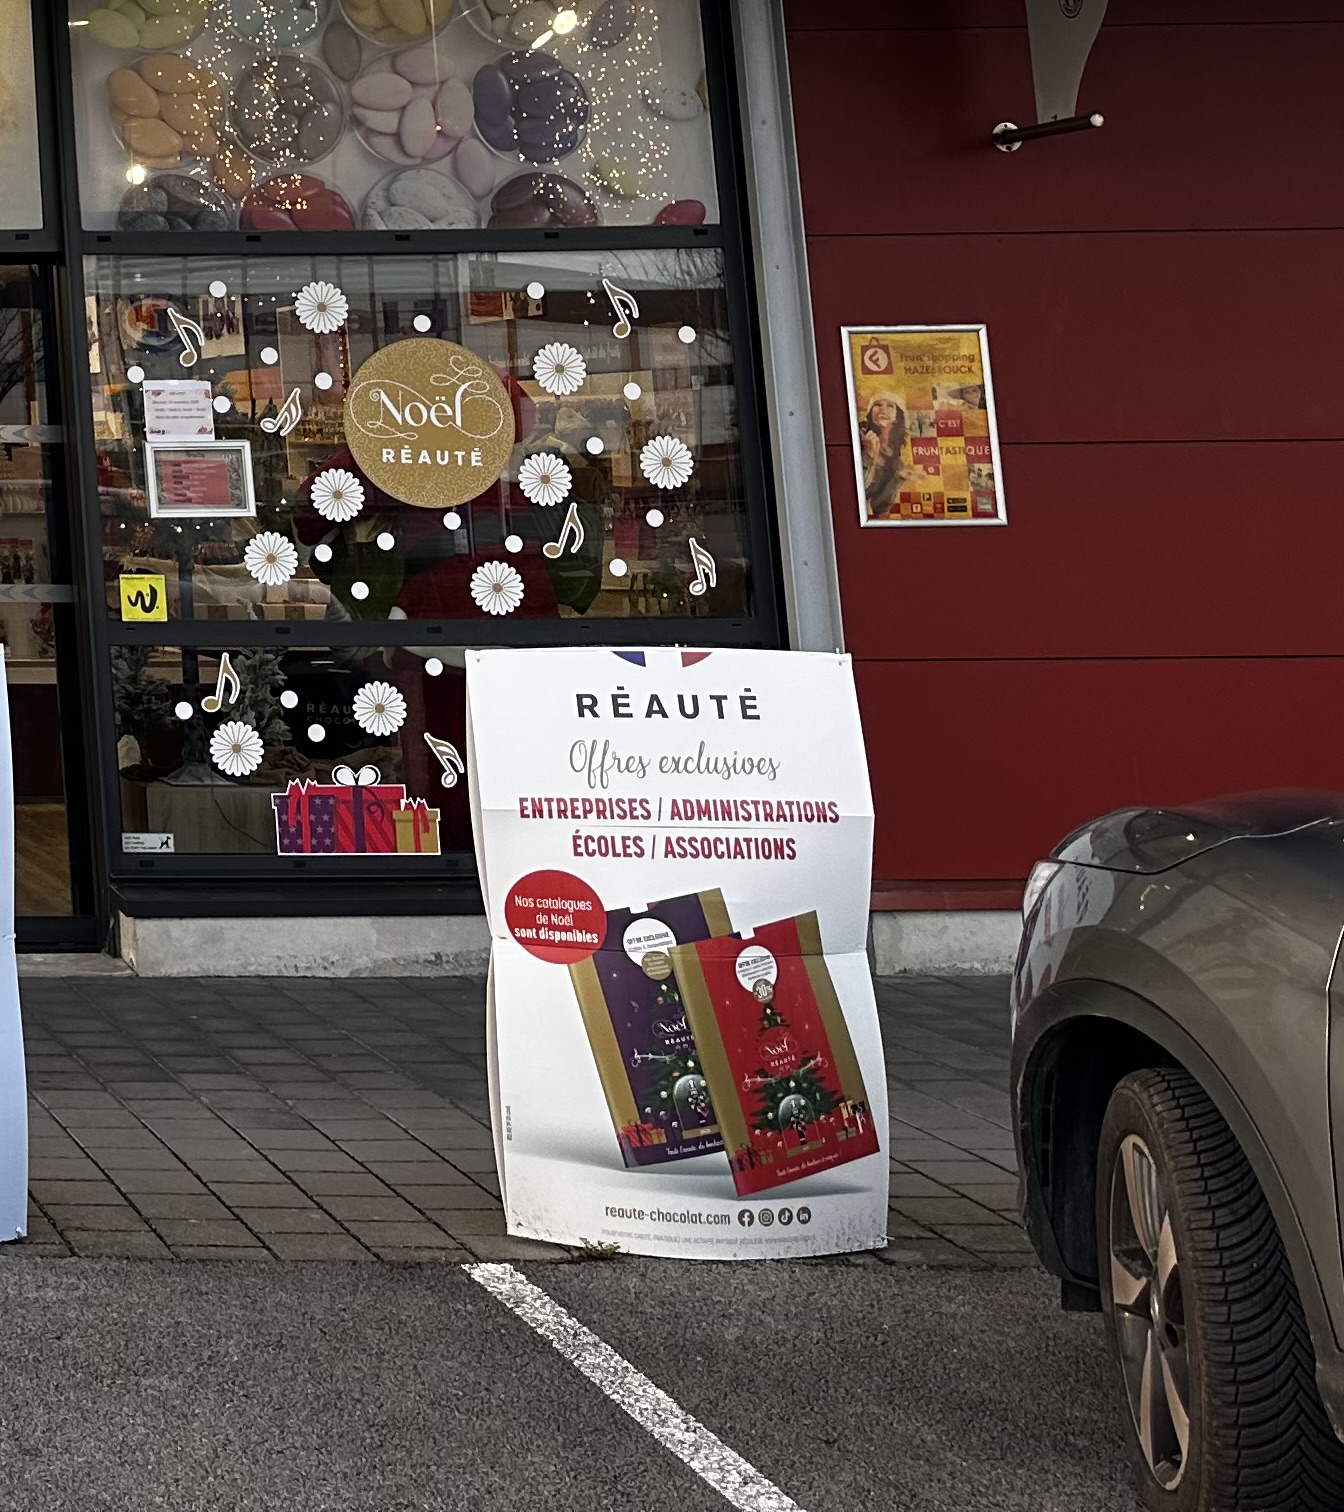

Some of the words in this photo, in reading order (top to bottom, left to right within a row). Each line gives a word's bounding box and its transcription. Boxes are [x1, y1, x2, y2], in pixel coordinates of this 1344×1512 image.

[381, 445, 484, 467] RÉAUTÉ
[575, 686, 761, 721] RÉAUTÉ
[569, 739, 651, 789] Offres
[658, 740, 781, 781] exclusives
[518, 796, 652, 821] ENTREPRISES
[670, 798, 840, 824] ADMINISTRATIONS
[572, 829, 645, 859] ÉCOLES
[663, 834, 797, 861] ASSOCIATIONS
[514, 895, 535, 910] Nos
[536, 896, 593, 913] catalogues
[536, 911, 549, 925] de
[551, 912, 574, 927] Noël
[514, 925, 537, 941] sont
[539, 926, 599, 946] disponibles
[605, 1204, 731, 1227] reaute-chocolat.com
